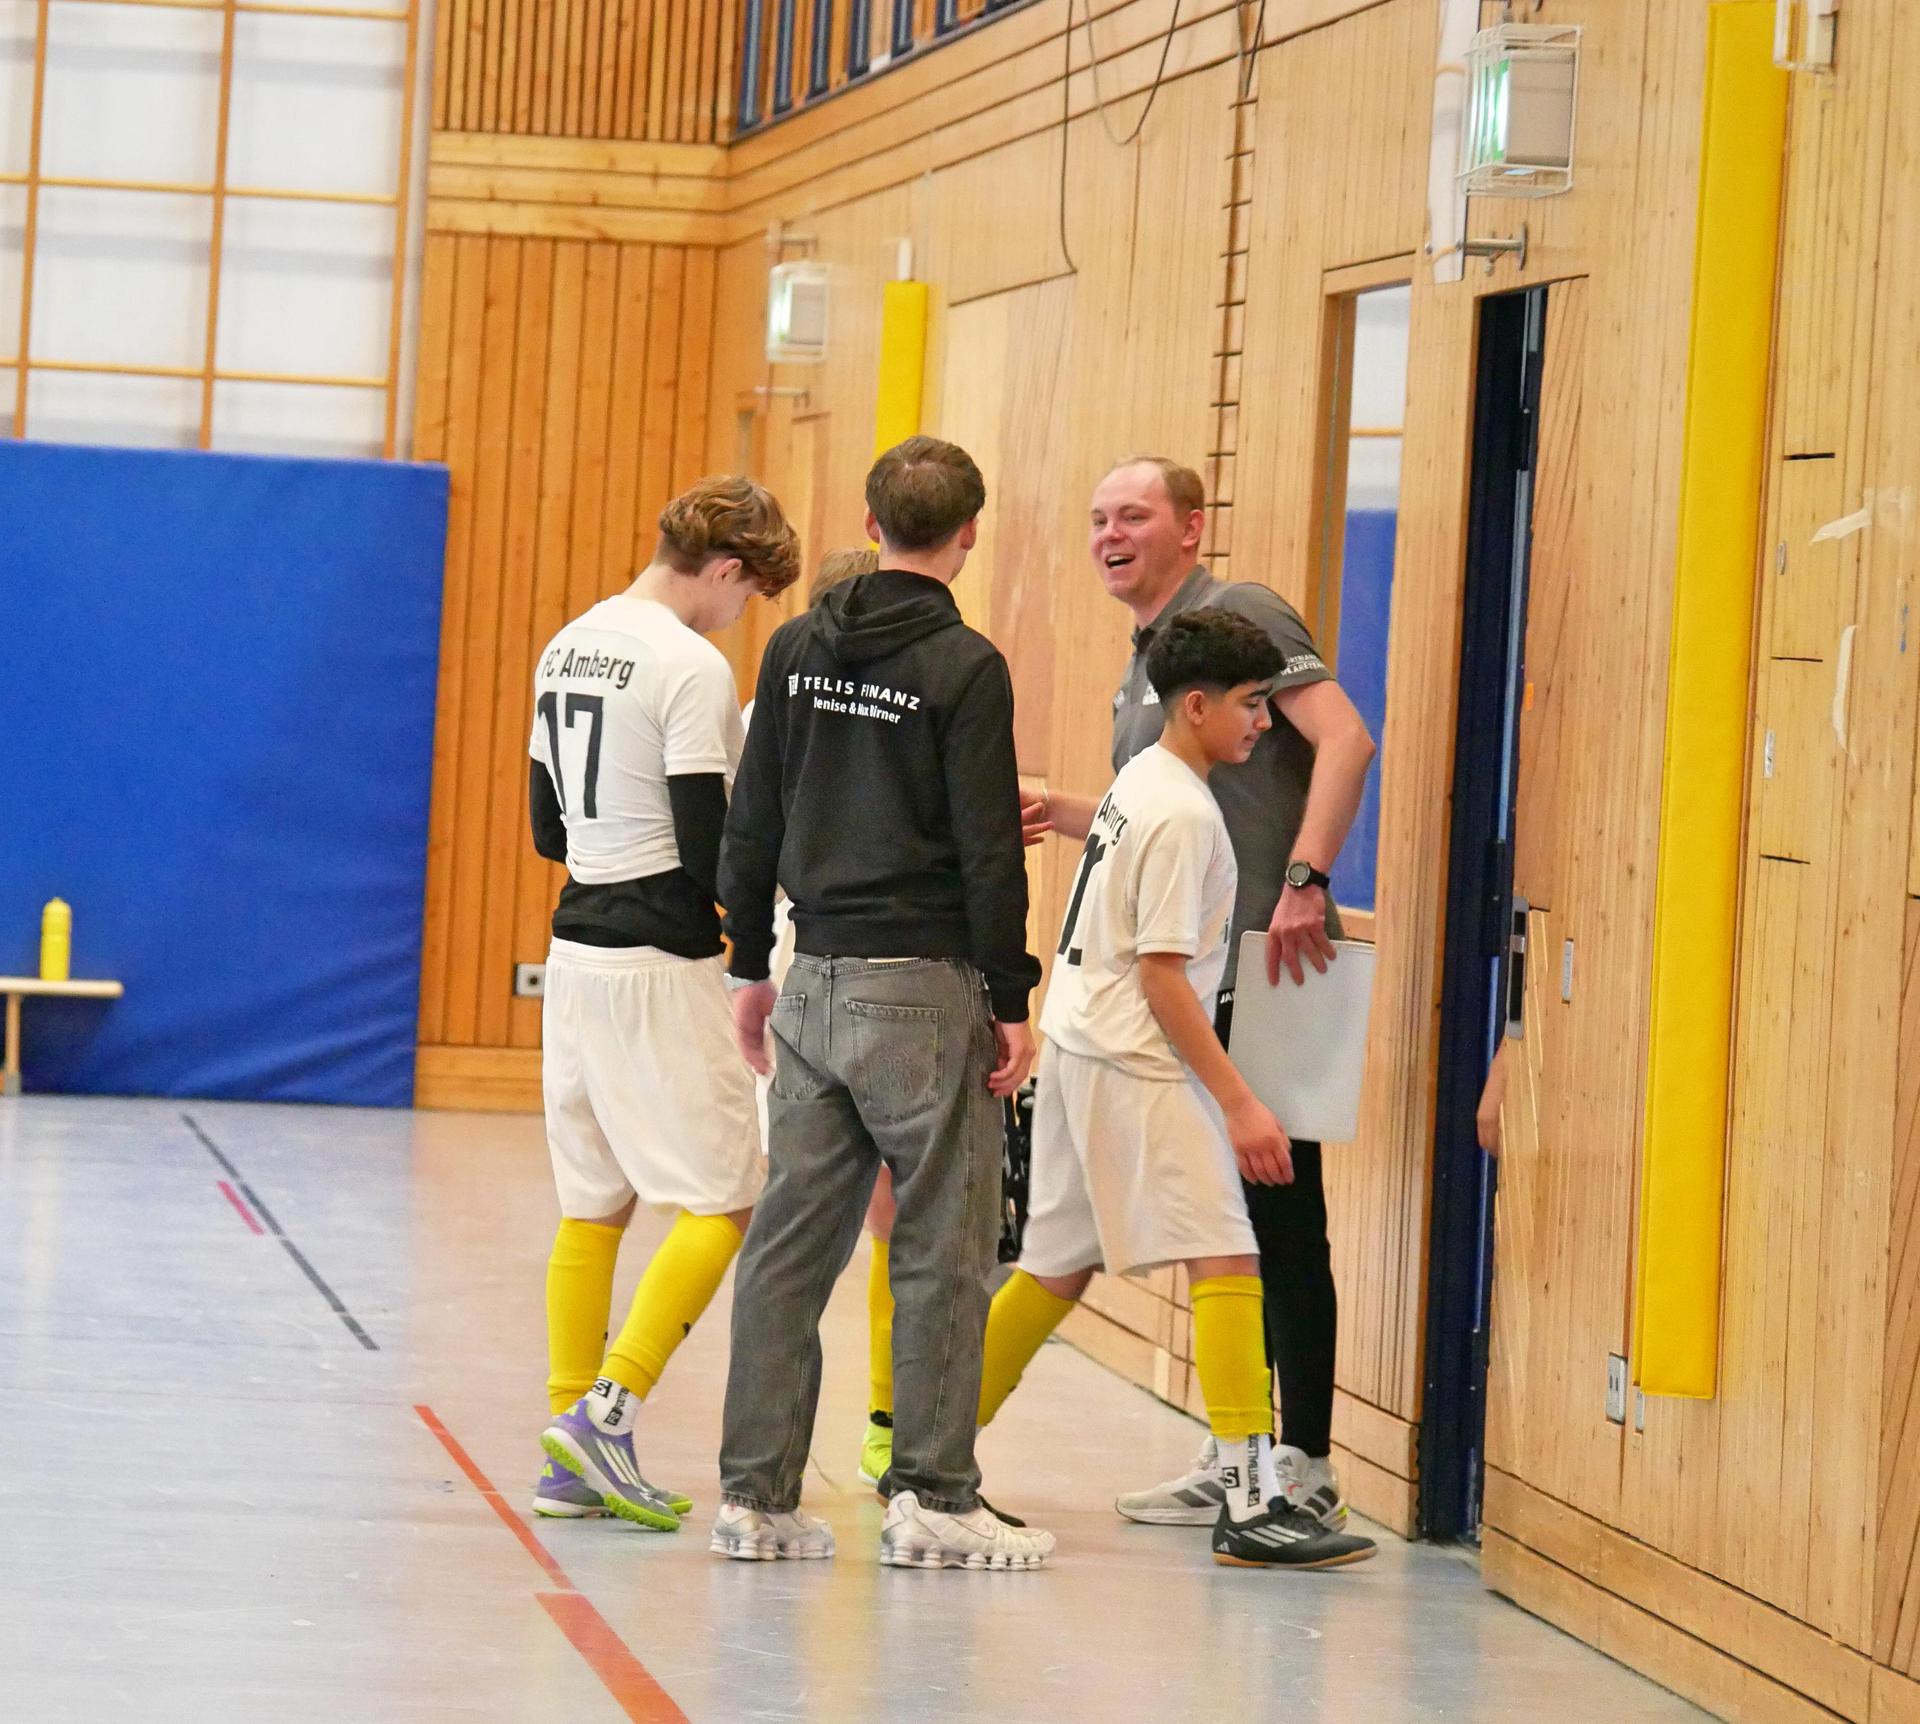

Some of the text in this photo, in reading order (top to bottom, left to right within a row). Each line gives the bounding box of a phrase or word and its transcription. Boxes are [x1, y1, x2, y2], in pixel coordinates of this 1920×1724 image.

[559, 647, 636, 690] Amberg
[803, 676, 921, 711] TELIS FINANZ
[848, 701, 857, 715] &
[537, 691, 604, 819] 17
